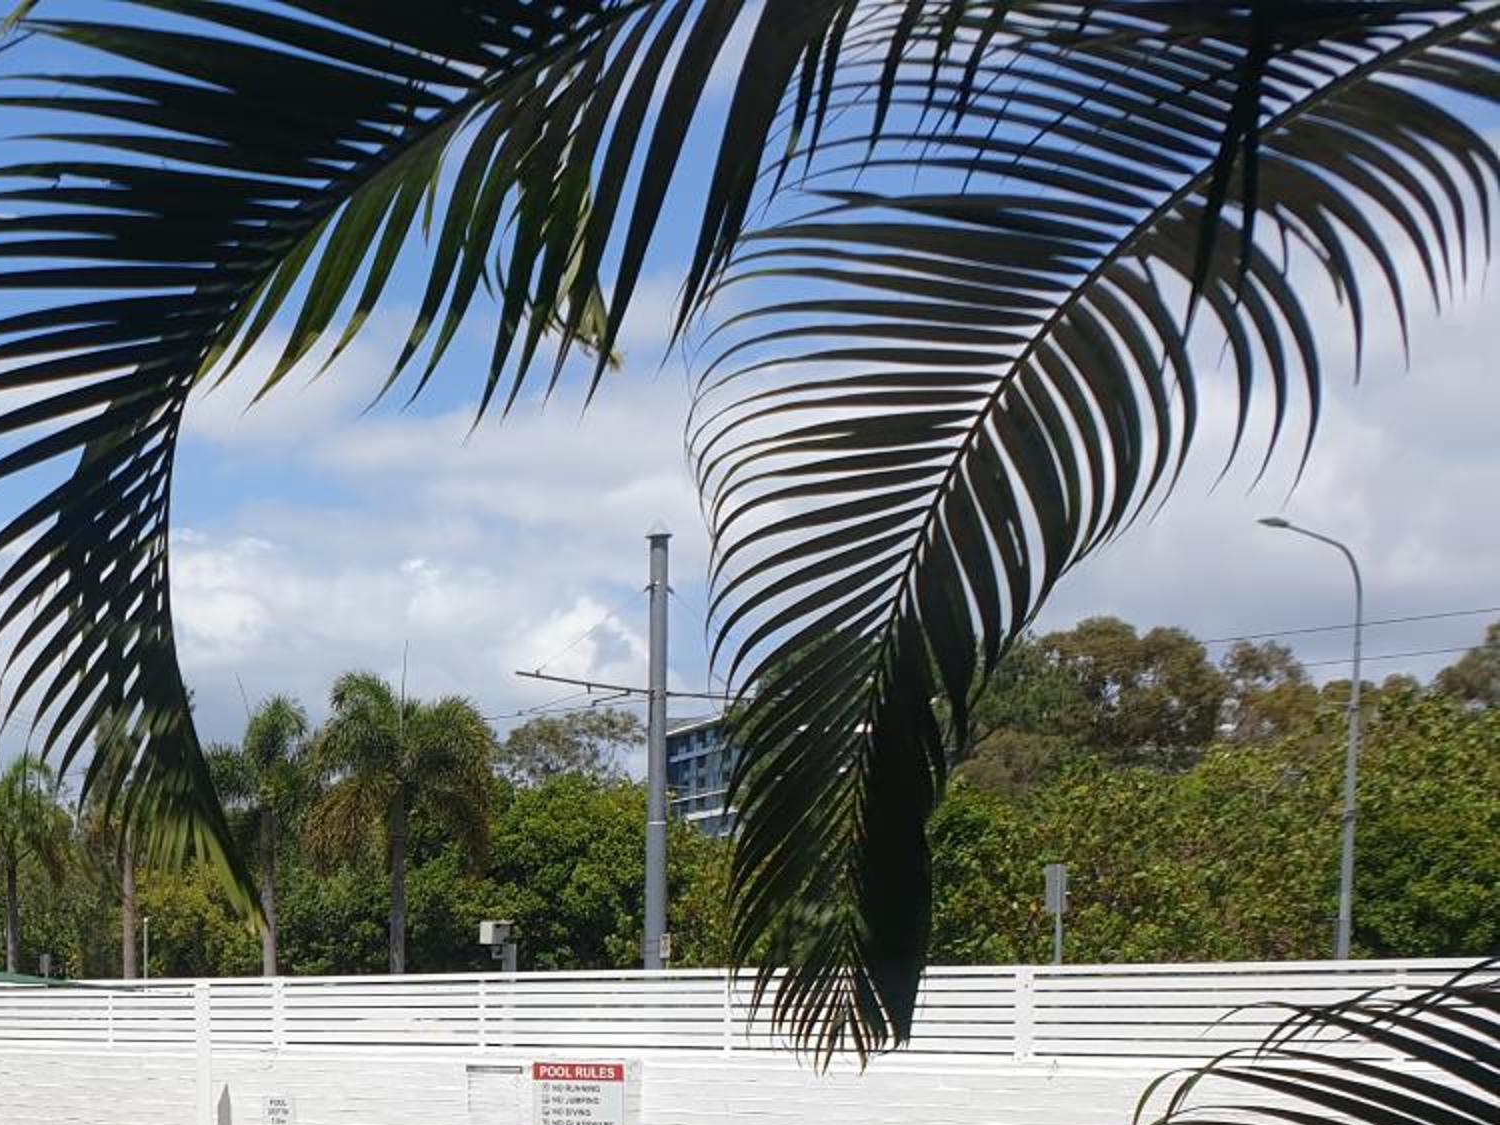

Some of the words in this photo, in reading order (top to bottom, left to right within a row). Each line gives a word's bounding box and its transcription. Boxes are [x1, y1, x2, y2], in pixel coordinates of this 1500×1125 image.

[540, 1066, 572, 1078] POOL
[575, 1066, 615, 1079] RULES
[552, 1084, 564, 1092] NO
[565, 1084, 601, 1093] RUNNING
